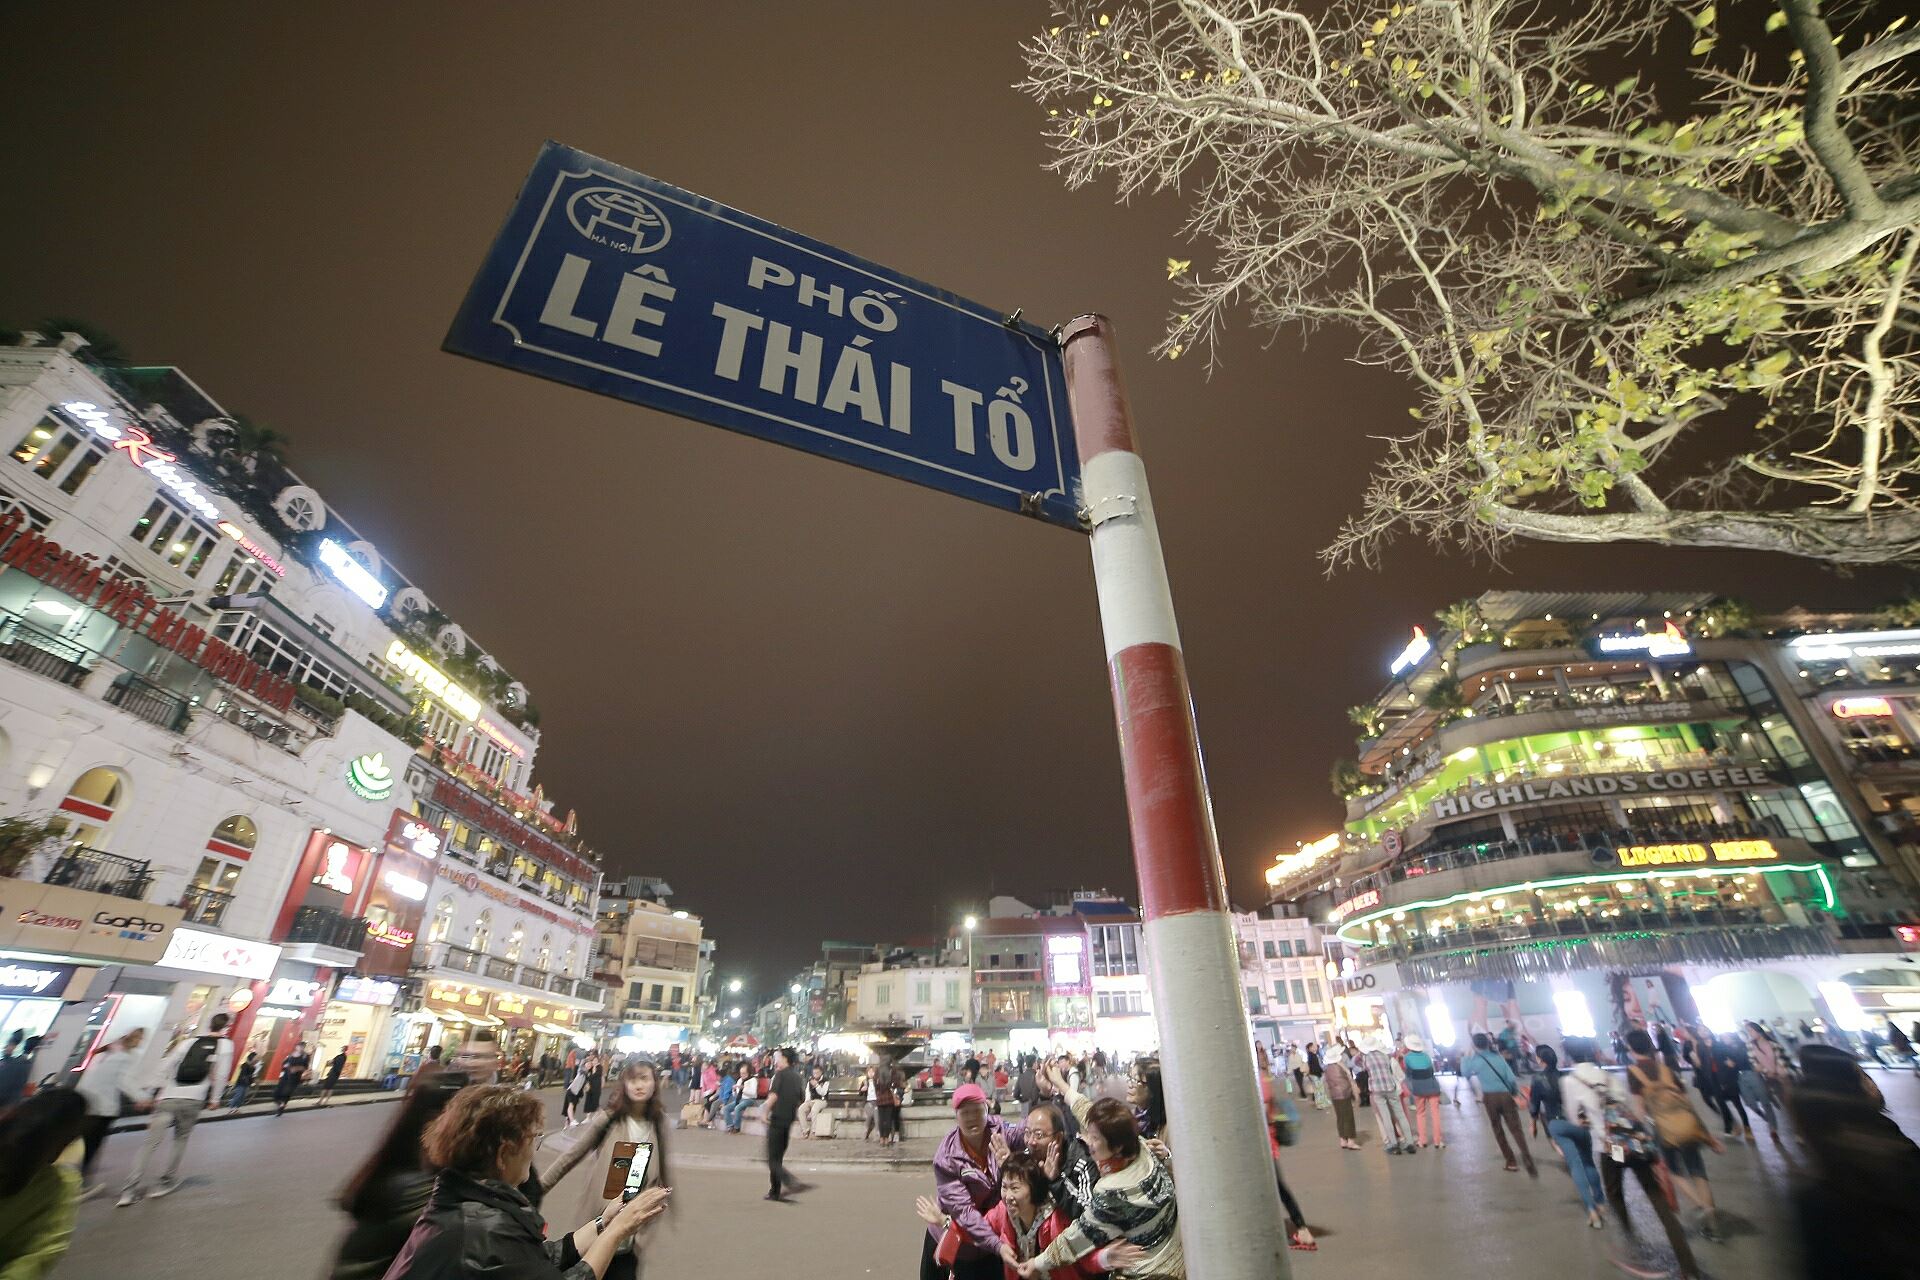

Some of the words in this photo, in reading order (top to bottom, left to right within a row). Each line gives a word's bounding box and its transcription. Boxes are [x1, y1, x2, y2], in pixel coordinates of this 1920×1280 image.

[591, 234, 607, 245] HÀ
[610, 240, 632, 254] NỘI
[747, 255, 906, 333] PHỐ
[538, 252, 677, 358] LÊ
[711, 301, 912, 435] THÁI
[941, 376, 1037, 472] TỔ
[3, 526, 104, 604] NGHĨA
[147, 606, 207, 661] NAM
[1434, 771, 1638, 819] HIGHLANDS
[1646, 766, 1769, 792] COFFEE
[1617, 842, 1708, 867] LEGEND
[1709, 839, 1778, 862] BEER
[17, 909, 83, 930] Canon
[94, 911, 165, 933] GoPro
